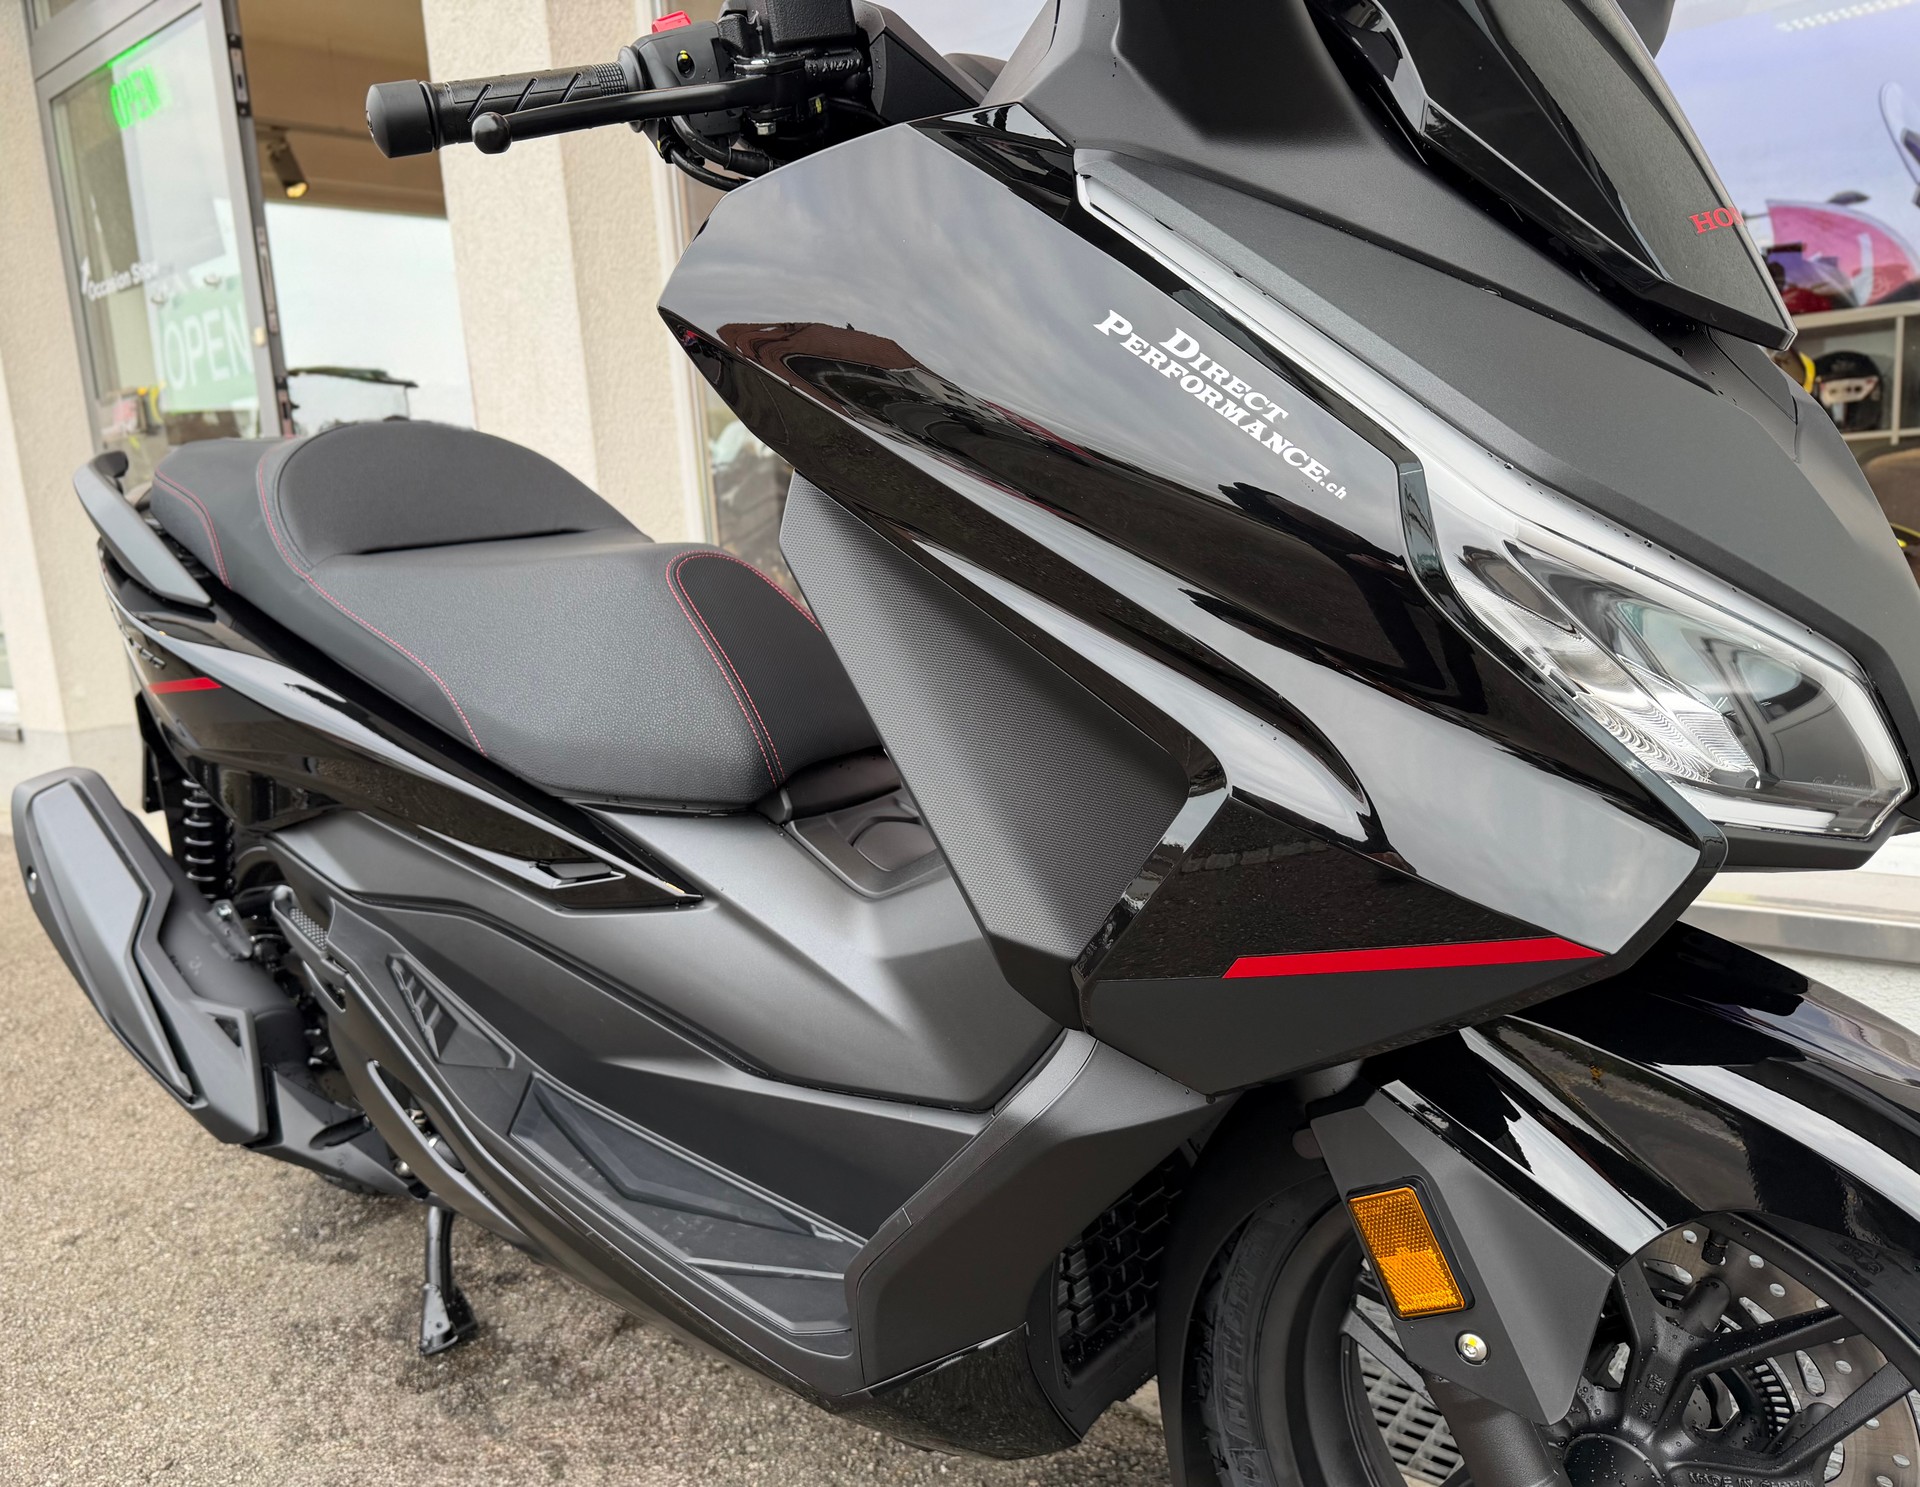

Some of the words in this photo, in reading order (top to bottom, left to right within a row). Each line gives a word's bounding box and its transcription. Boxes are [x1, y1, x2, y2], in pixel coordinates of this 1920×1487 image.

[108, 64, 161, 129] OPEN
[163, 301, 254, 390] OPEN
[1159, 327, 1289, 424] DIRECT
[1221, 1265, 1257, 1430] MICHELIN
